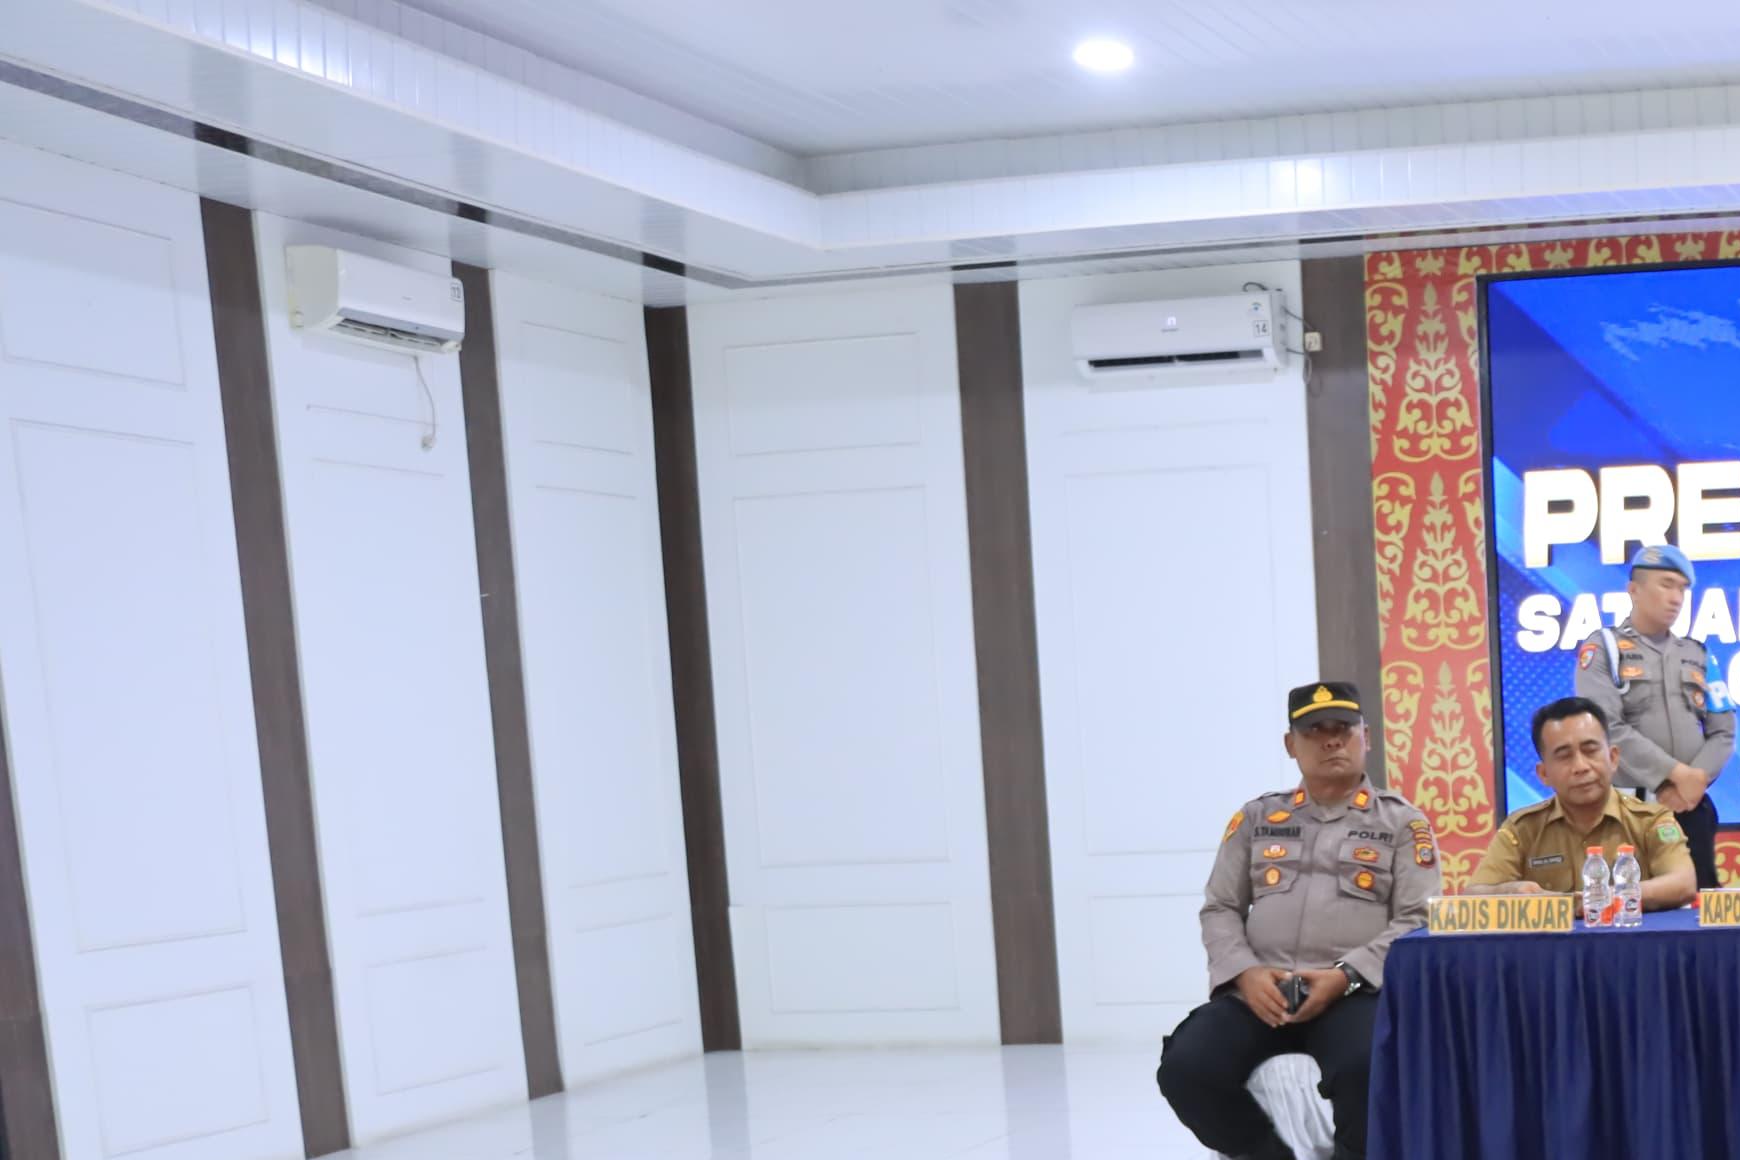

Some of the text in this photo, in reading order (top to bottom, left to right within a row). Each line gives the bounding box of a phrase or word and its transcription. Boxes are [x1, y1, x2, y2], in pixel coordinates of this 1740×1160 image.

[1348, 830, 1394, 843] POLRI
[1430, 898, 1570, 931] KADIS DIKJAR
